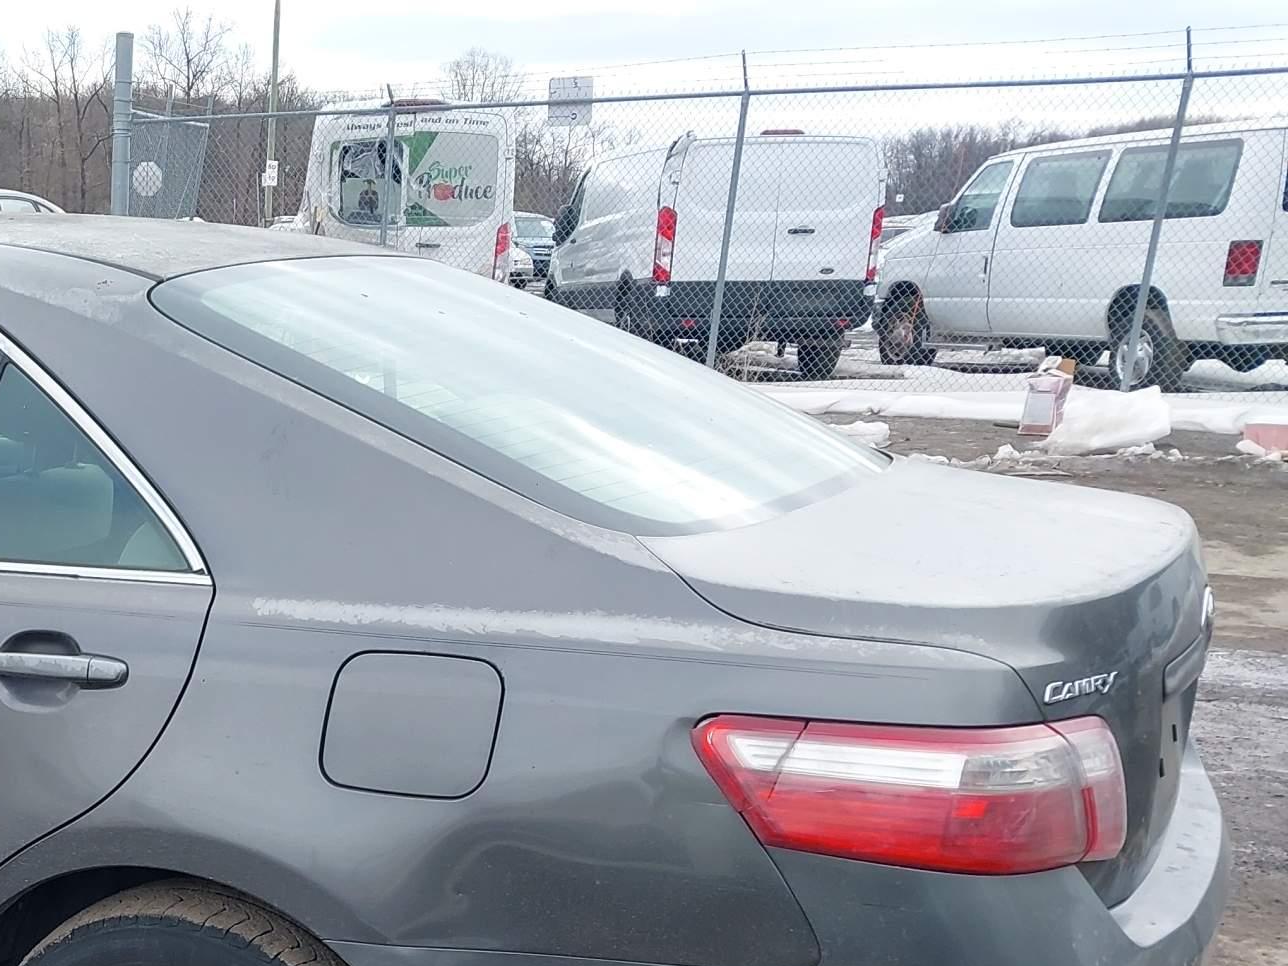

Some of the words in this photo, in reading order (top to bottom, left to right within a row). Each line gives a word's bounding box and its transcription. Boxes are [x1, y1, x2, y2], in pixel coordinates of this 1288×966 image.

[420, 116, 442, 124] and
[463, 117, 490, 126] Time
[428, 160, 473, 184] Super
[1043, 671, 1118, 704] CAMRY
